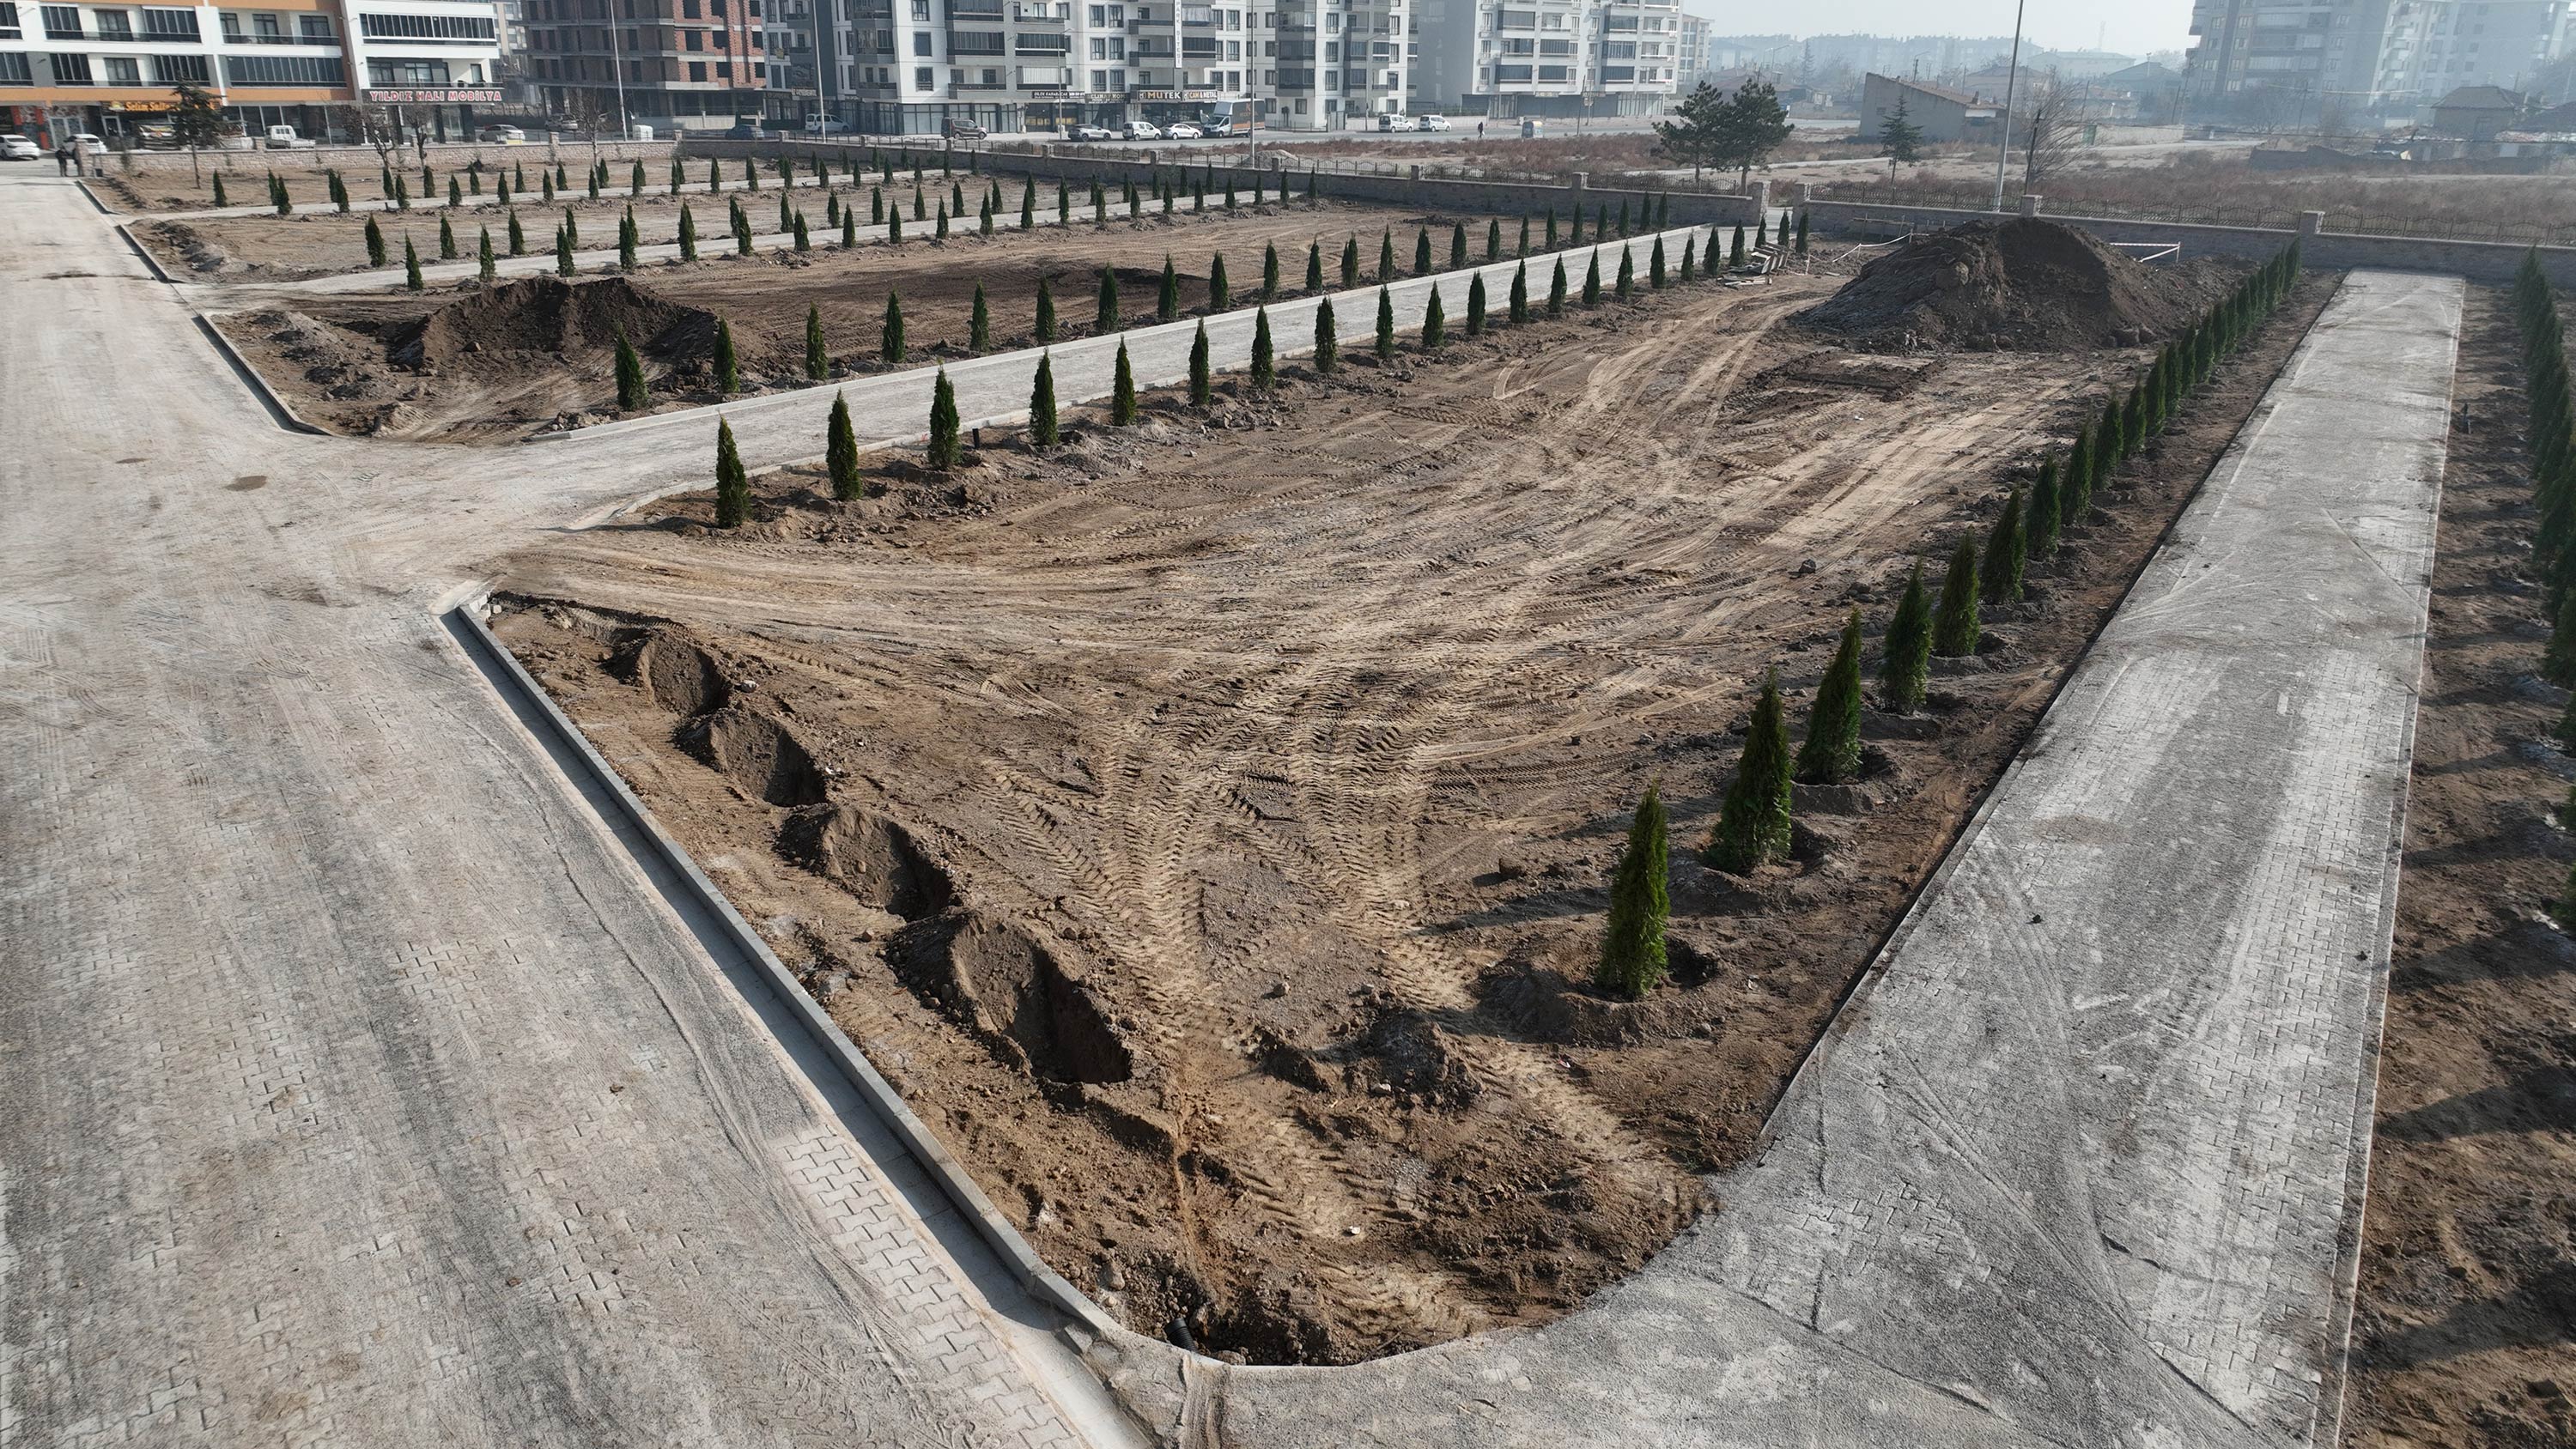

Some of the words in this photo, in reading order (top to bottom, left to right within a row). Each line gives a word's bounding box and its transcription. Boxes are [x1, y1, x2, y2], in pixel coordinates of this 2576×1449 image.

[369, 90, 412, 102] YILDIZ
[416, 90, 445, 102] HALI
[447, 89, 502, 101] MOBİLYA
[1147, 91, 1182, 100] MUTEK
